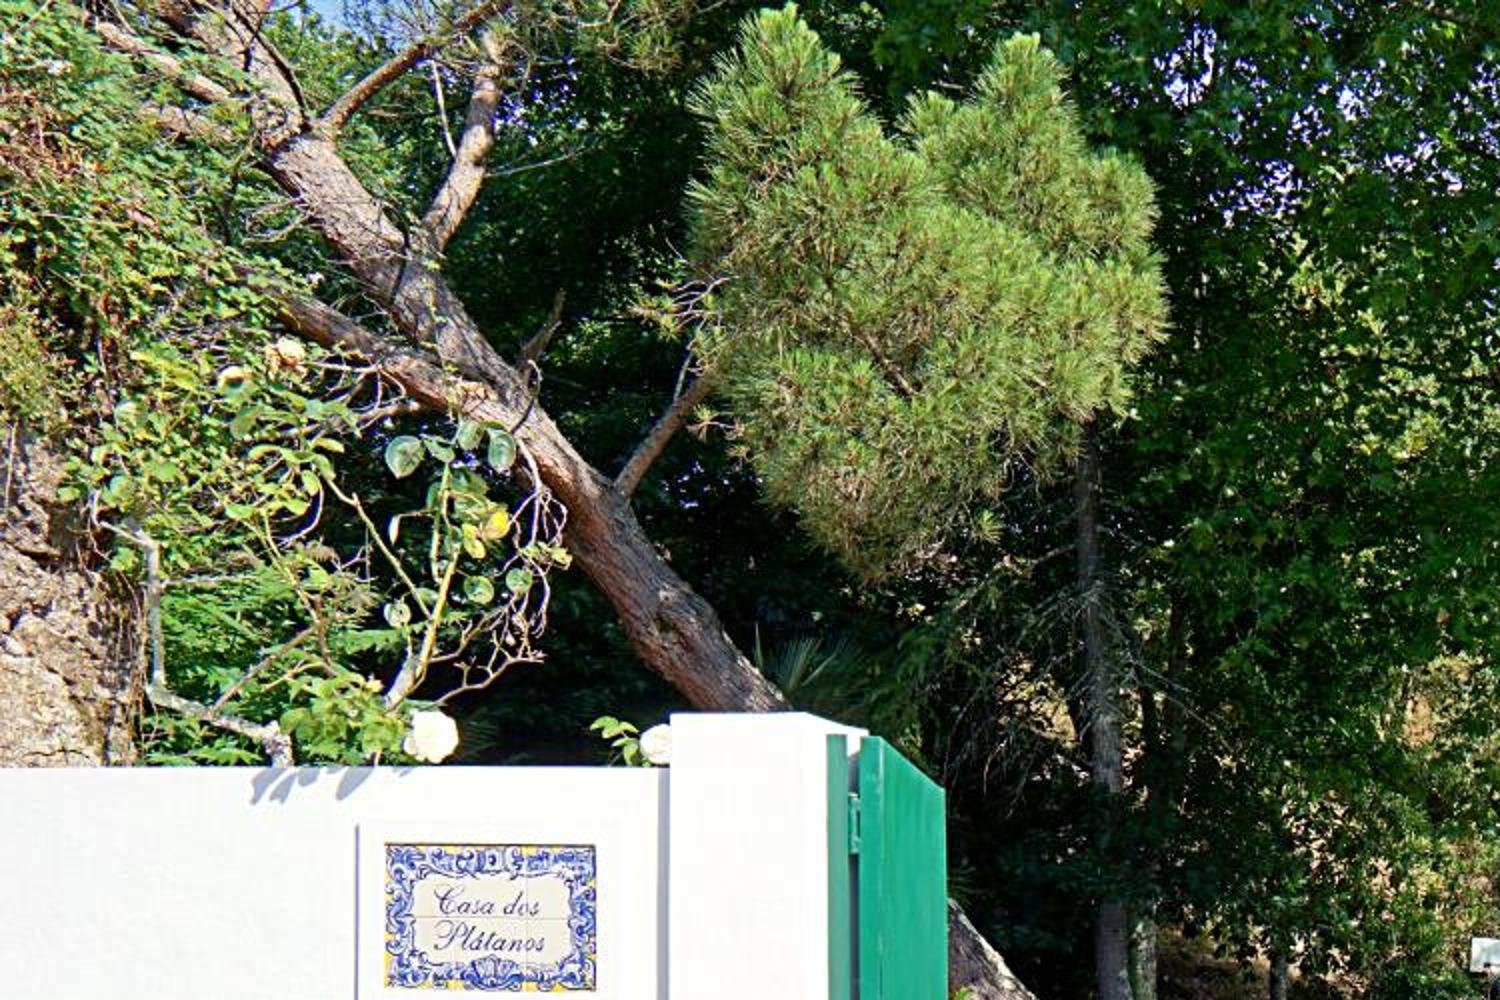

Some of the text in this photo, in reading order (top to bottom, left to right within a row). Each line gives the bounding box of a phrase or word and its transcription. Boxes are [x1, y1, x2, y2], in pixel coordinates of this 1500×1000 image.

[433, 884, 540, 916] Casa dos
[433, 920, 545, 952] Plátanos
